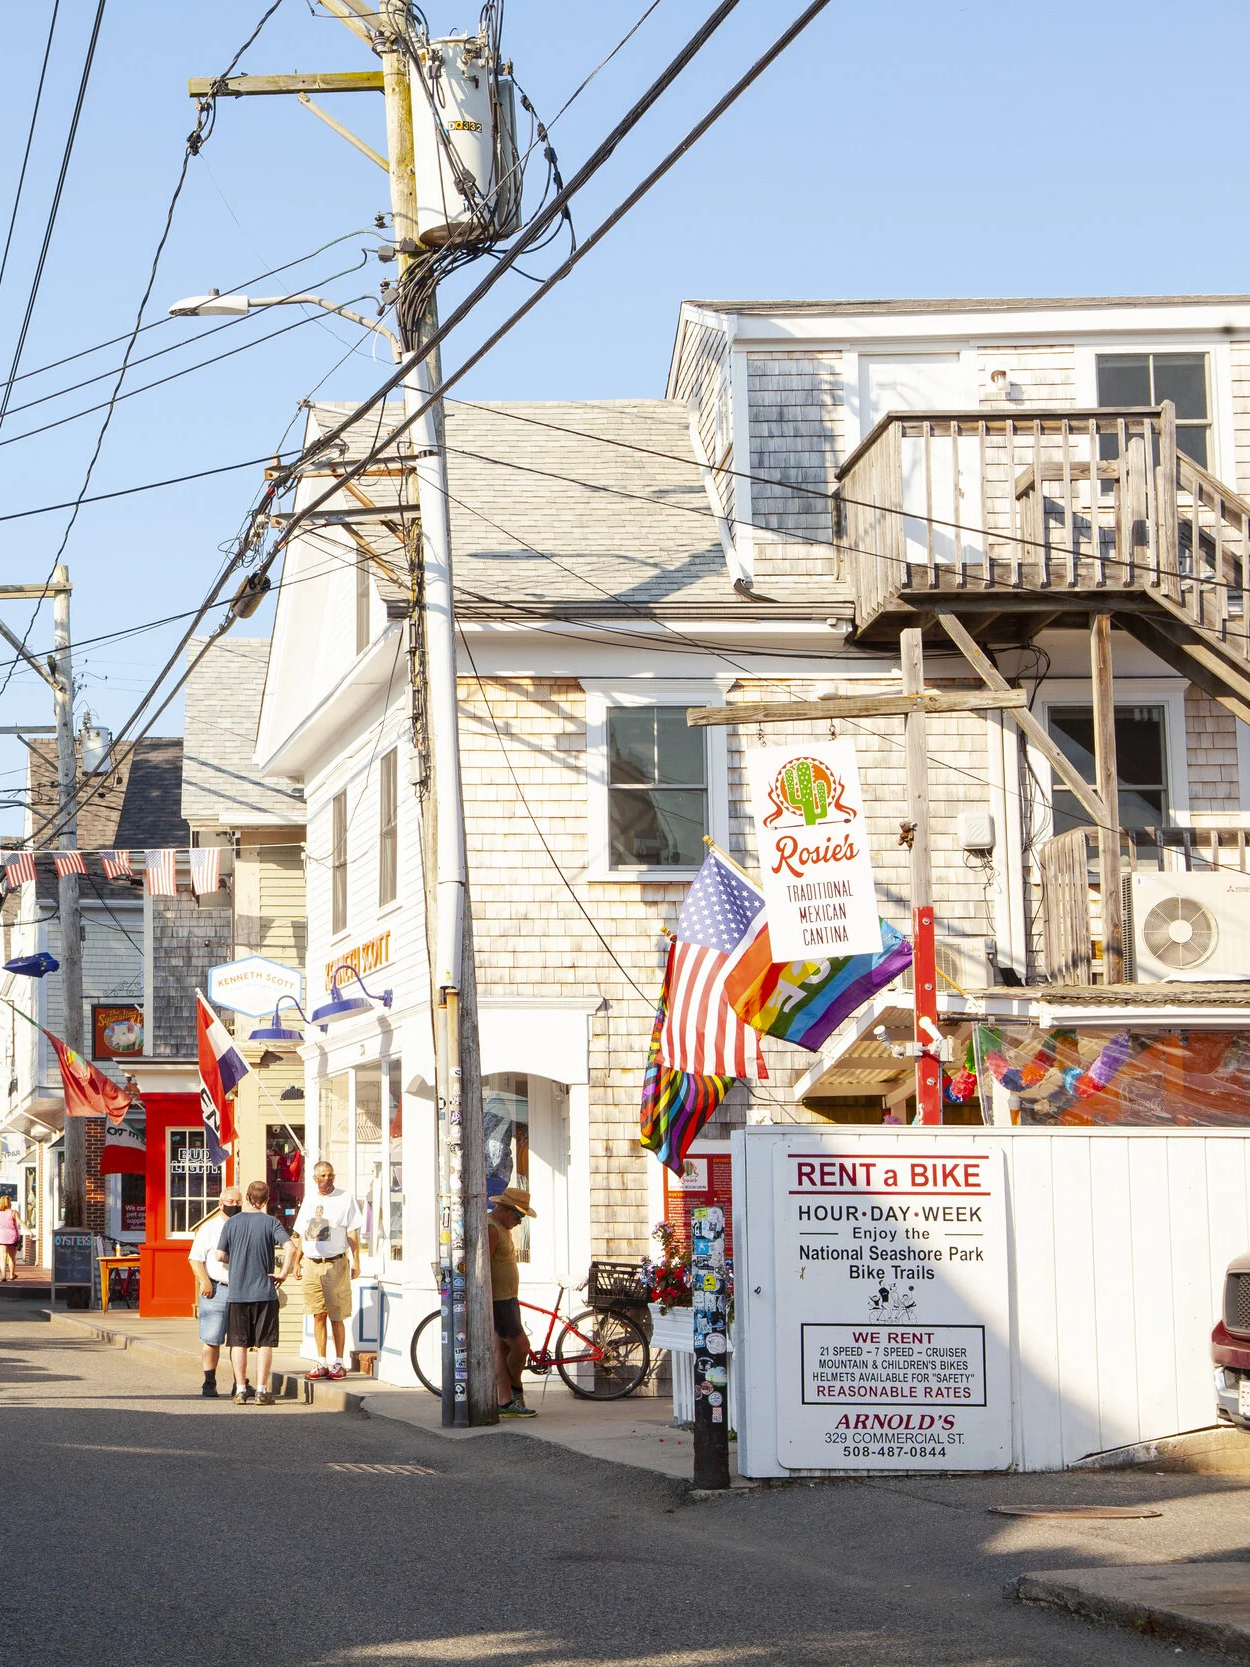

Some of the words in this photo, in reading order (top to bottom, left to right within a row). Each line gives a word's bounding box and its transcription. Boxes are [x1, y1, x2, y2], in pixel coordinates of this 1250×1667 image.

[772, 833, 860, 878] Rosie's
[786, 880, 853, 902] TRADITIONAL
[799, 903, 846, 923] MEXICAN
[803, 926, 849, 946] CANTINA
[218, 972, 263, 987] KENNETH
[266, 974, 294, 989] SCOTT
[798, 1163, 876, 1186] RENT
[884, 1169, 898, 1186] a
[910, 1164, 981, 1187] BIKE
[55, 1235, 91, 1246] OYSTERS
[853, 1228, 897, 1242] Enjoy
[905, 1228, 930, 1239] the
[800, 1245, 863, 1260] National
[870, 1246, 943, 1261] Seashore
[949, 1247, 984, 1261] Park
[849, 1265, 885, 1279] Bike
[893, 1266, 935, 1280] Trails
[853, 1332, 880, 1344] WE
[888, 1333, 934, 1344] RENT
[820, 1347, 830, 1356] 21
[832, 1347, 863, 1356] SPEED
[875, 1347, 880, 1357] 7
[883, 1347, 914, 1357] SPEED
[926, 1348, 967, 1357] CRUISER
[819, 1359, 869, 1369] MOUNTAIN
[871, 1360, 878, 1369] &
[881, 1360, 937, 1370] CHILDREN'S
[940, 1360, 968, 1370] BIKES
[812, 1372, 856, 1382] HELMETS
[859, 1372, 909, 1382] AVAILABLE
[911, 1373, 930, 1382] FOR
[932, 1373, 974, 1383] "SAFETY"
[817, 1385, 918, 1398] REASONABLE
[924, 1387, 971, 1398] RATES
[835, 1414, 956, 1430] ARNOLD'S
[824, 1433, 847, 1444] 329
[853, 1433, 944, 1444] COMMERCIAL
[947, 1434, 965, 1444] ST.
[843, 1447, 946, 1457] 508-487-0844
